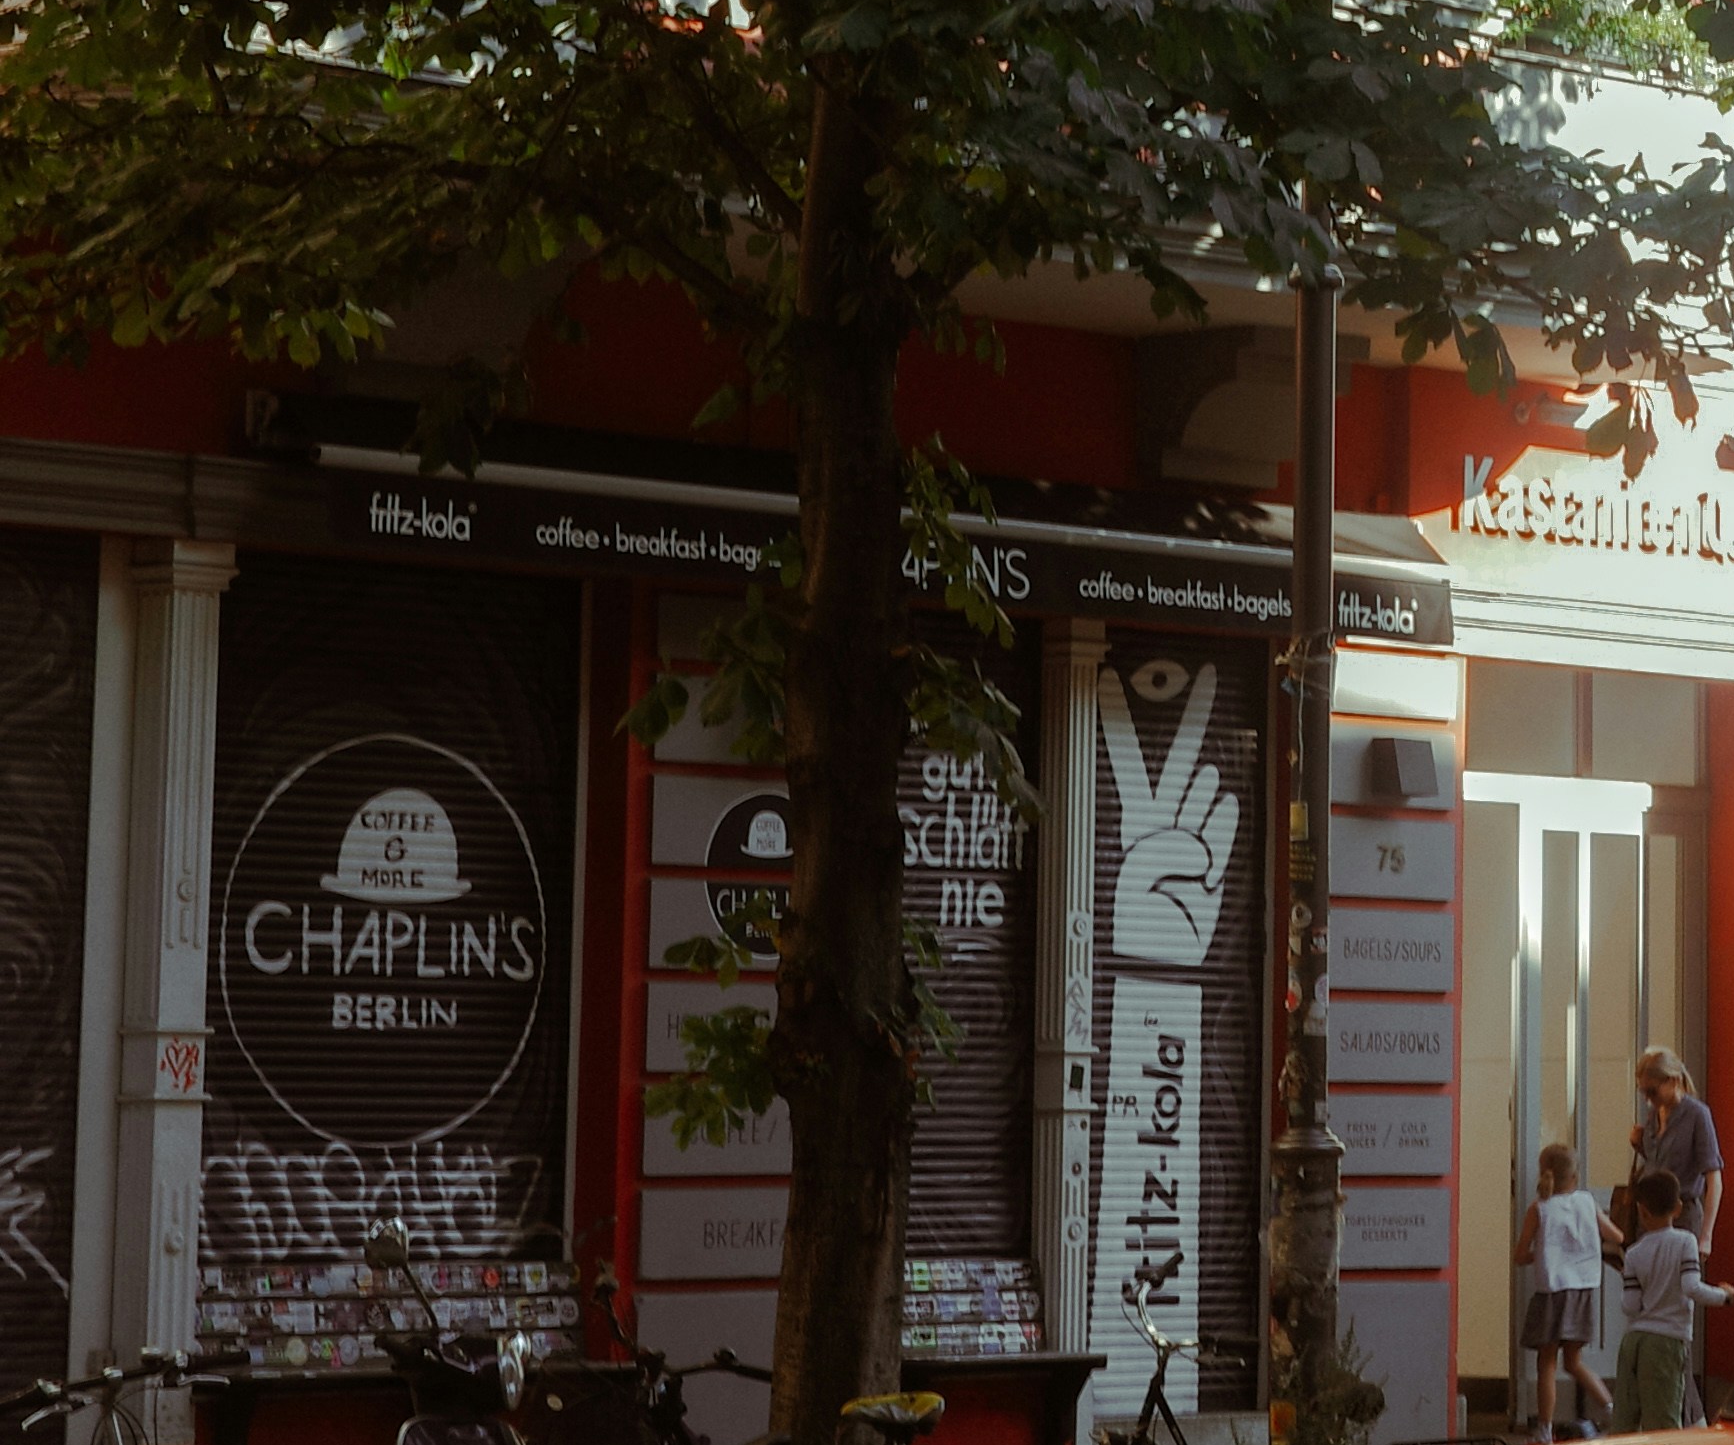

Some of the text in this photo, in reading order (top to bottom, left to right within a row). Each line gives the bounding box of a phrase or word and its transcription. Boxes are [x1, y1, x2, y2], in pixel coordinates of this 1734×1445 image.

[369, 491, 471, 543] fritz-kola
[535, 516, 782, 572] coffee breakfast bag
[1079, 570, 1293, 622] coffee breakfast bagels
[1338, 589, 1416, 635] fritz-kola
[360, 810, 435, 832] COFFEE
[360, 868, 425, 889] MORE
[939, 876, 1006, 929] nie
[244, 900, 536, 983] CHAPLIN'S
[331, 992, 459, 1032] BERLIN
[1339, 1030, 1441, 1056] SALADS/BOWLS
